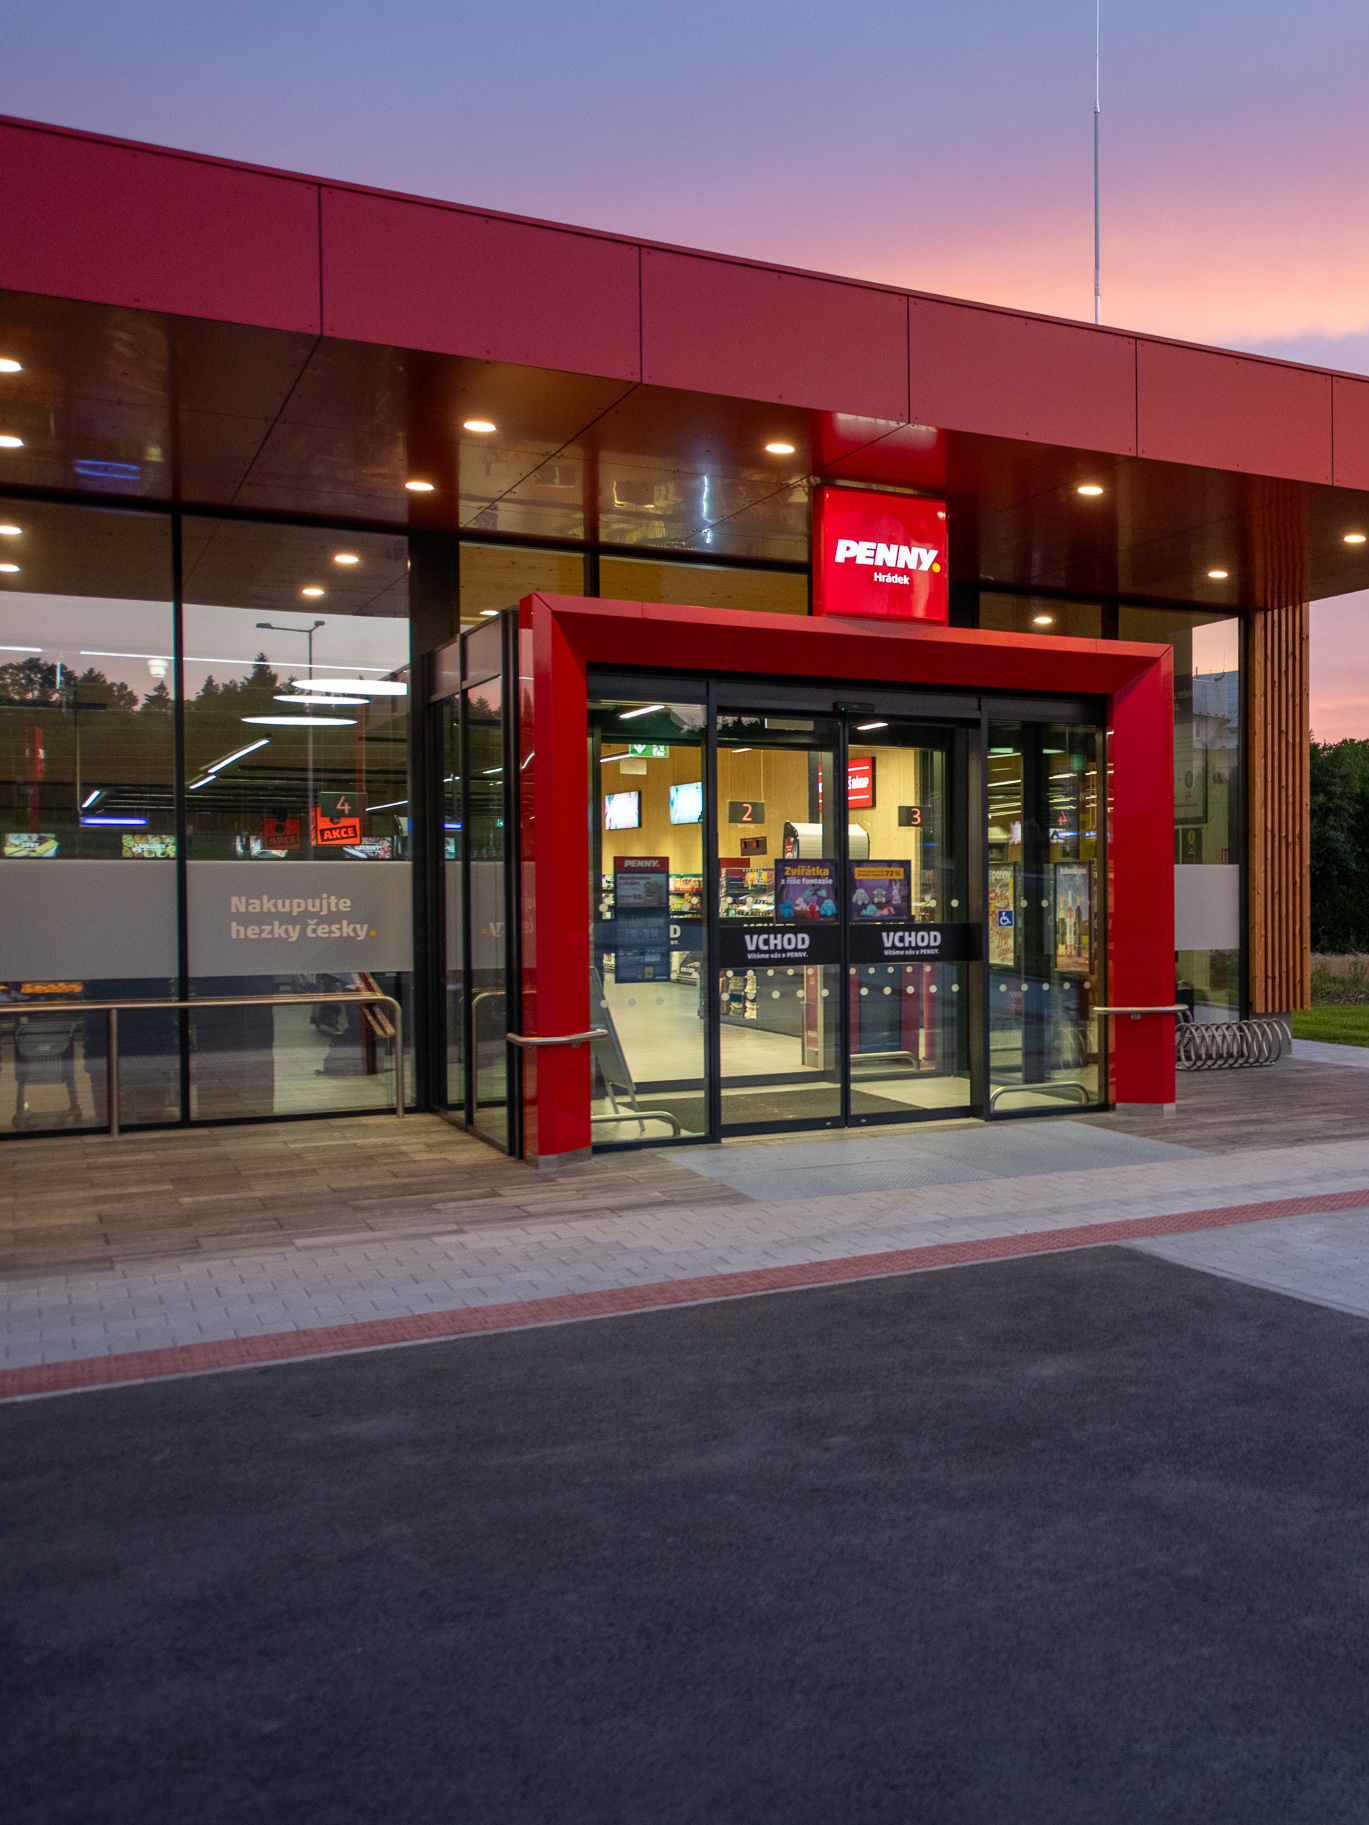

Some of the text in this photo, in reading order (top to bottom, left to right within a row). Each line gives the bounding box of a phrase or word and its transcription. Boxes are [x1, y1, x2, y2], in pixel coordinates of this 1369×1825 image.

[834, 539, 941, 573] PENNY.
[873, 572, 910, 585] Hrádek
[336, 795, 352, 815] 4
[742, 803, 753, 822] 2
[911, 807, 922, 825] 3
[269, 835, 297, 847] AKCE
[323, 827, 356, 840] AKCE
[784, 865, 830, 876] Zvířátka
[786, 877, 801, 885] říše
[230, 893, 351, 916] Nakupujte
[230, 919, 377, 942] hezky česky.
[881, 930, 942, 948] VCHOD
[744, 933, 811, 951] VCHOD
[747, 952, 770, 960] Vítáme
